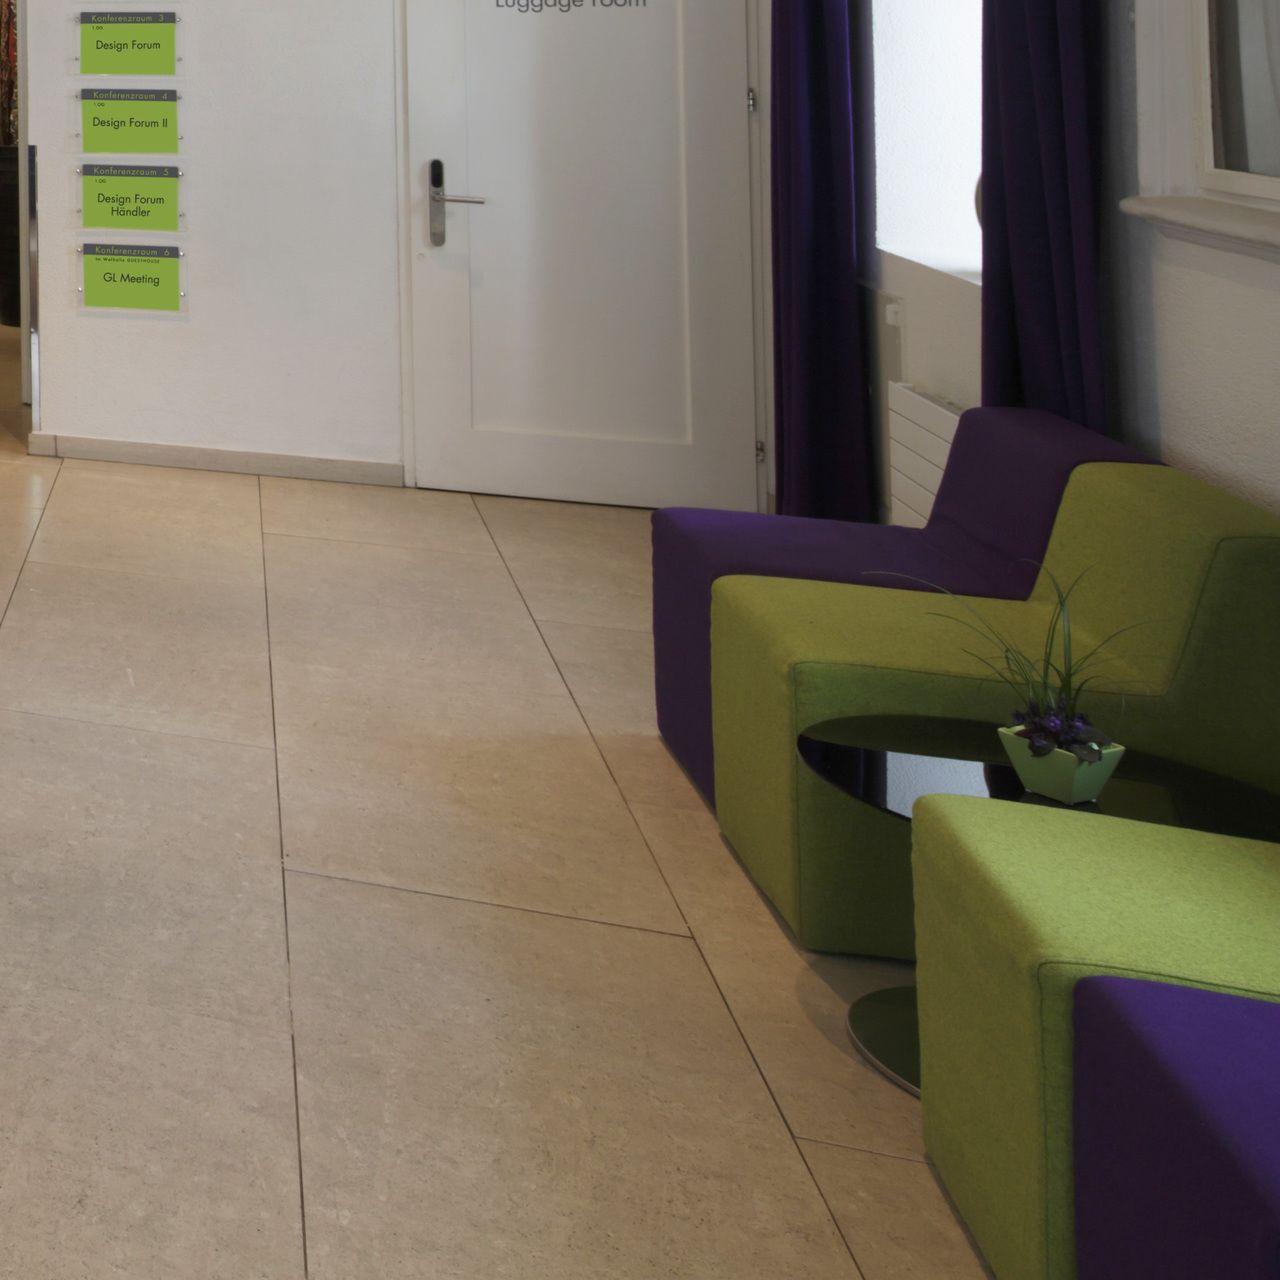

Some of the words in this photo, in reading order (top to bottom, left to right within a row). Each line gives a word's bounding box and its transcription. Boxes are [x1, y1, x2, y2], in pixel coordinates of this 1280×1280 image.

[91, 14, 153, 23] Konferenzraum
[159, 15, 164, 23] 3
[96, 40, 128, 52] Design
[131, 40, 161, 50] Forum
[93, 91, 156, 100] Konferenzraum
[162, 92, 168, 100] 4
[92, 117, 126, 129] Design
[129, 118, 159, 128] Forum
[162, 118, 168, 128] II
[93, 167, 157, 176] Konferenzraum
[163, 168, 169, 176] 5
[97, 193, 131, 206] Design
[134, 194, 165, 205] Forum
[111, 206, 151, 217] Händler
[95, 246, 158, 256] Konferenzraum
[164, 248, 170, 256] 6
[103, 272, 117, 283] GL
[120, 273, 160, 286] Meeting
